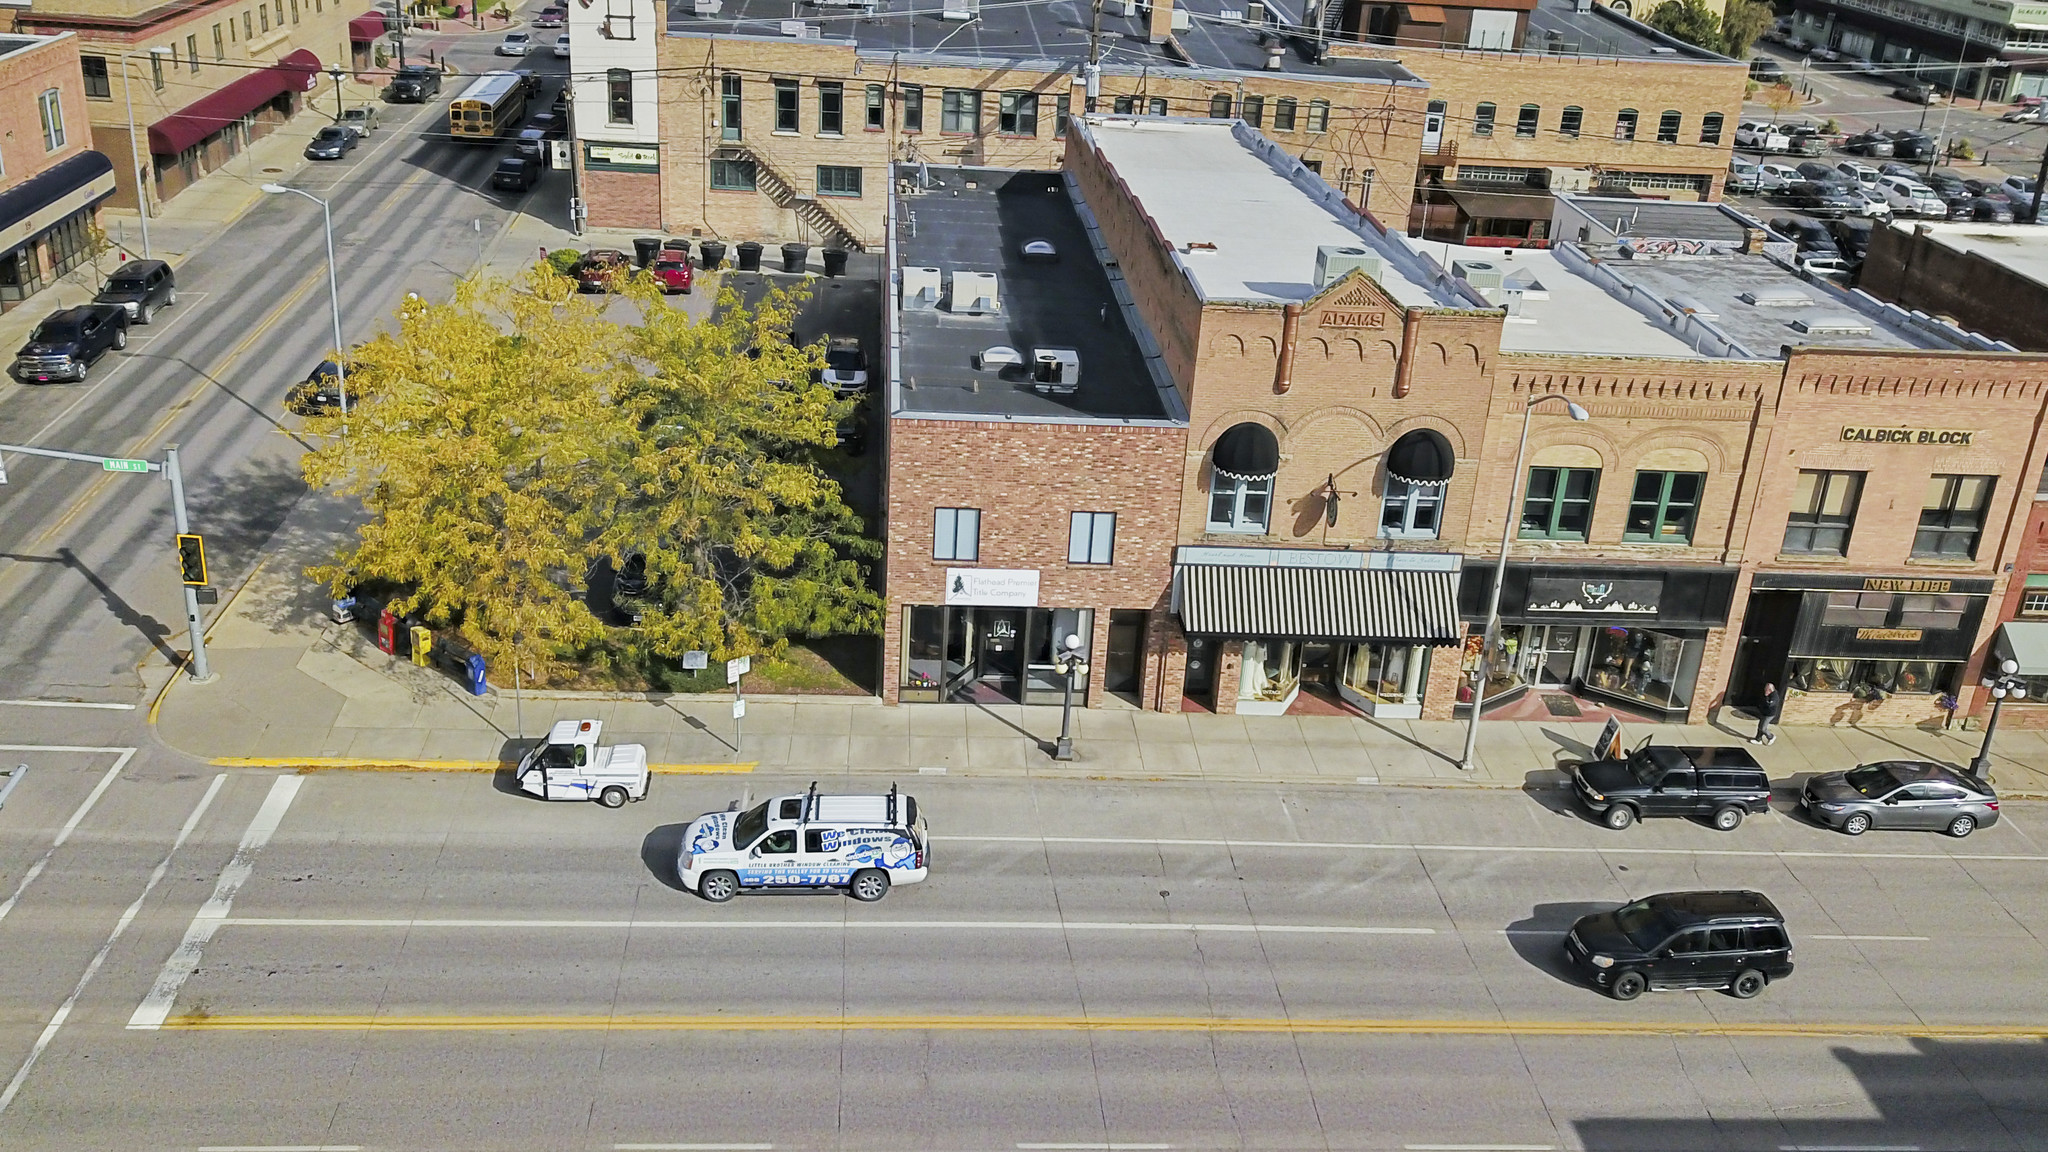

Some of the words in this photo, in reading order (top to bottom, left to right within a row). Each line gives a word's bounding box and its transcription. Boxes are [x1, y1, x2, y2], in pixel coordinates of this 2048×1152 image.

[1321, 312, 1381, 327] ADAMS
[1843, 428, 1914, 442] CALBICK
[1917, 431, 1973, 445] BLOCK
[109, 460, 129, 469] MAIN
[1288, 552, 1353, 565] BESTOW
[973, 577, 1006, 586] Flathead
[1007, 578, 1037, 586] Premier
[1865, 580, 1904, 591] NEW
[1910, 581, 1951, 592] LIFE
[973, 588, 988, 597] Title
[989, 589, 1026, 598] Company
[822, 830, 846, 841] We
[823, 836, 892, 851] Windows
[762, 873, 851, 884] 250-7787
